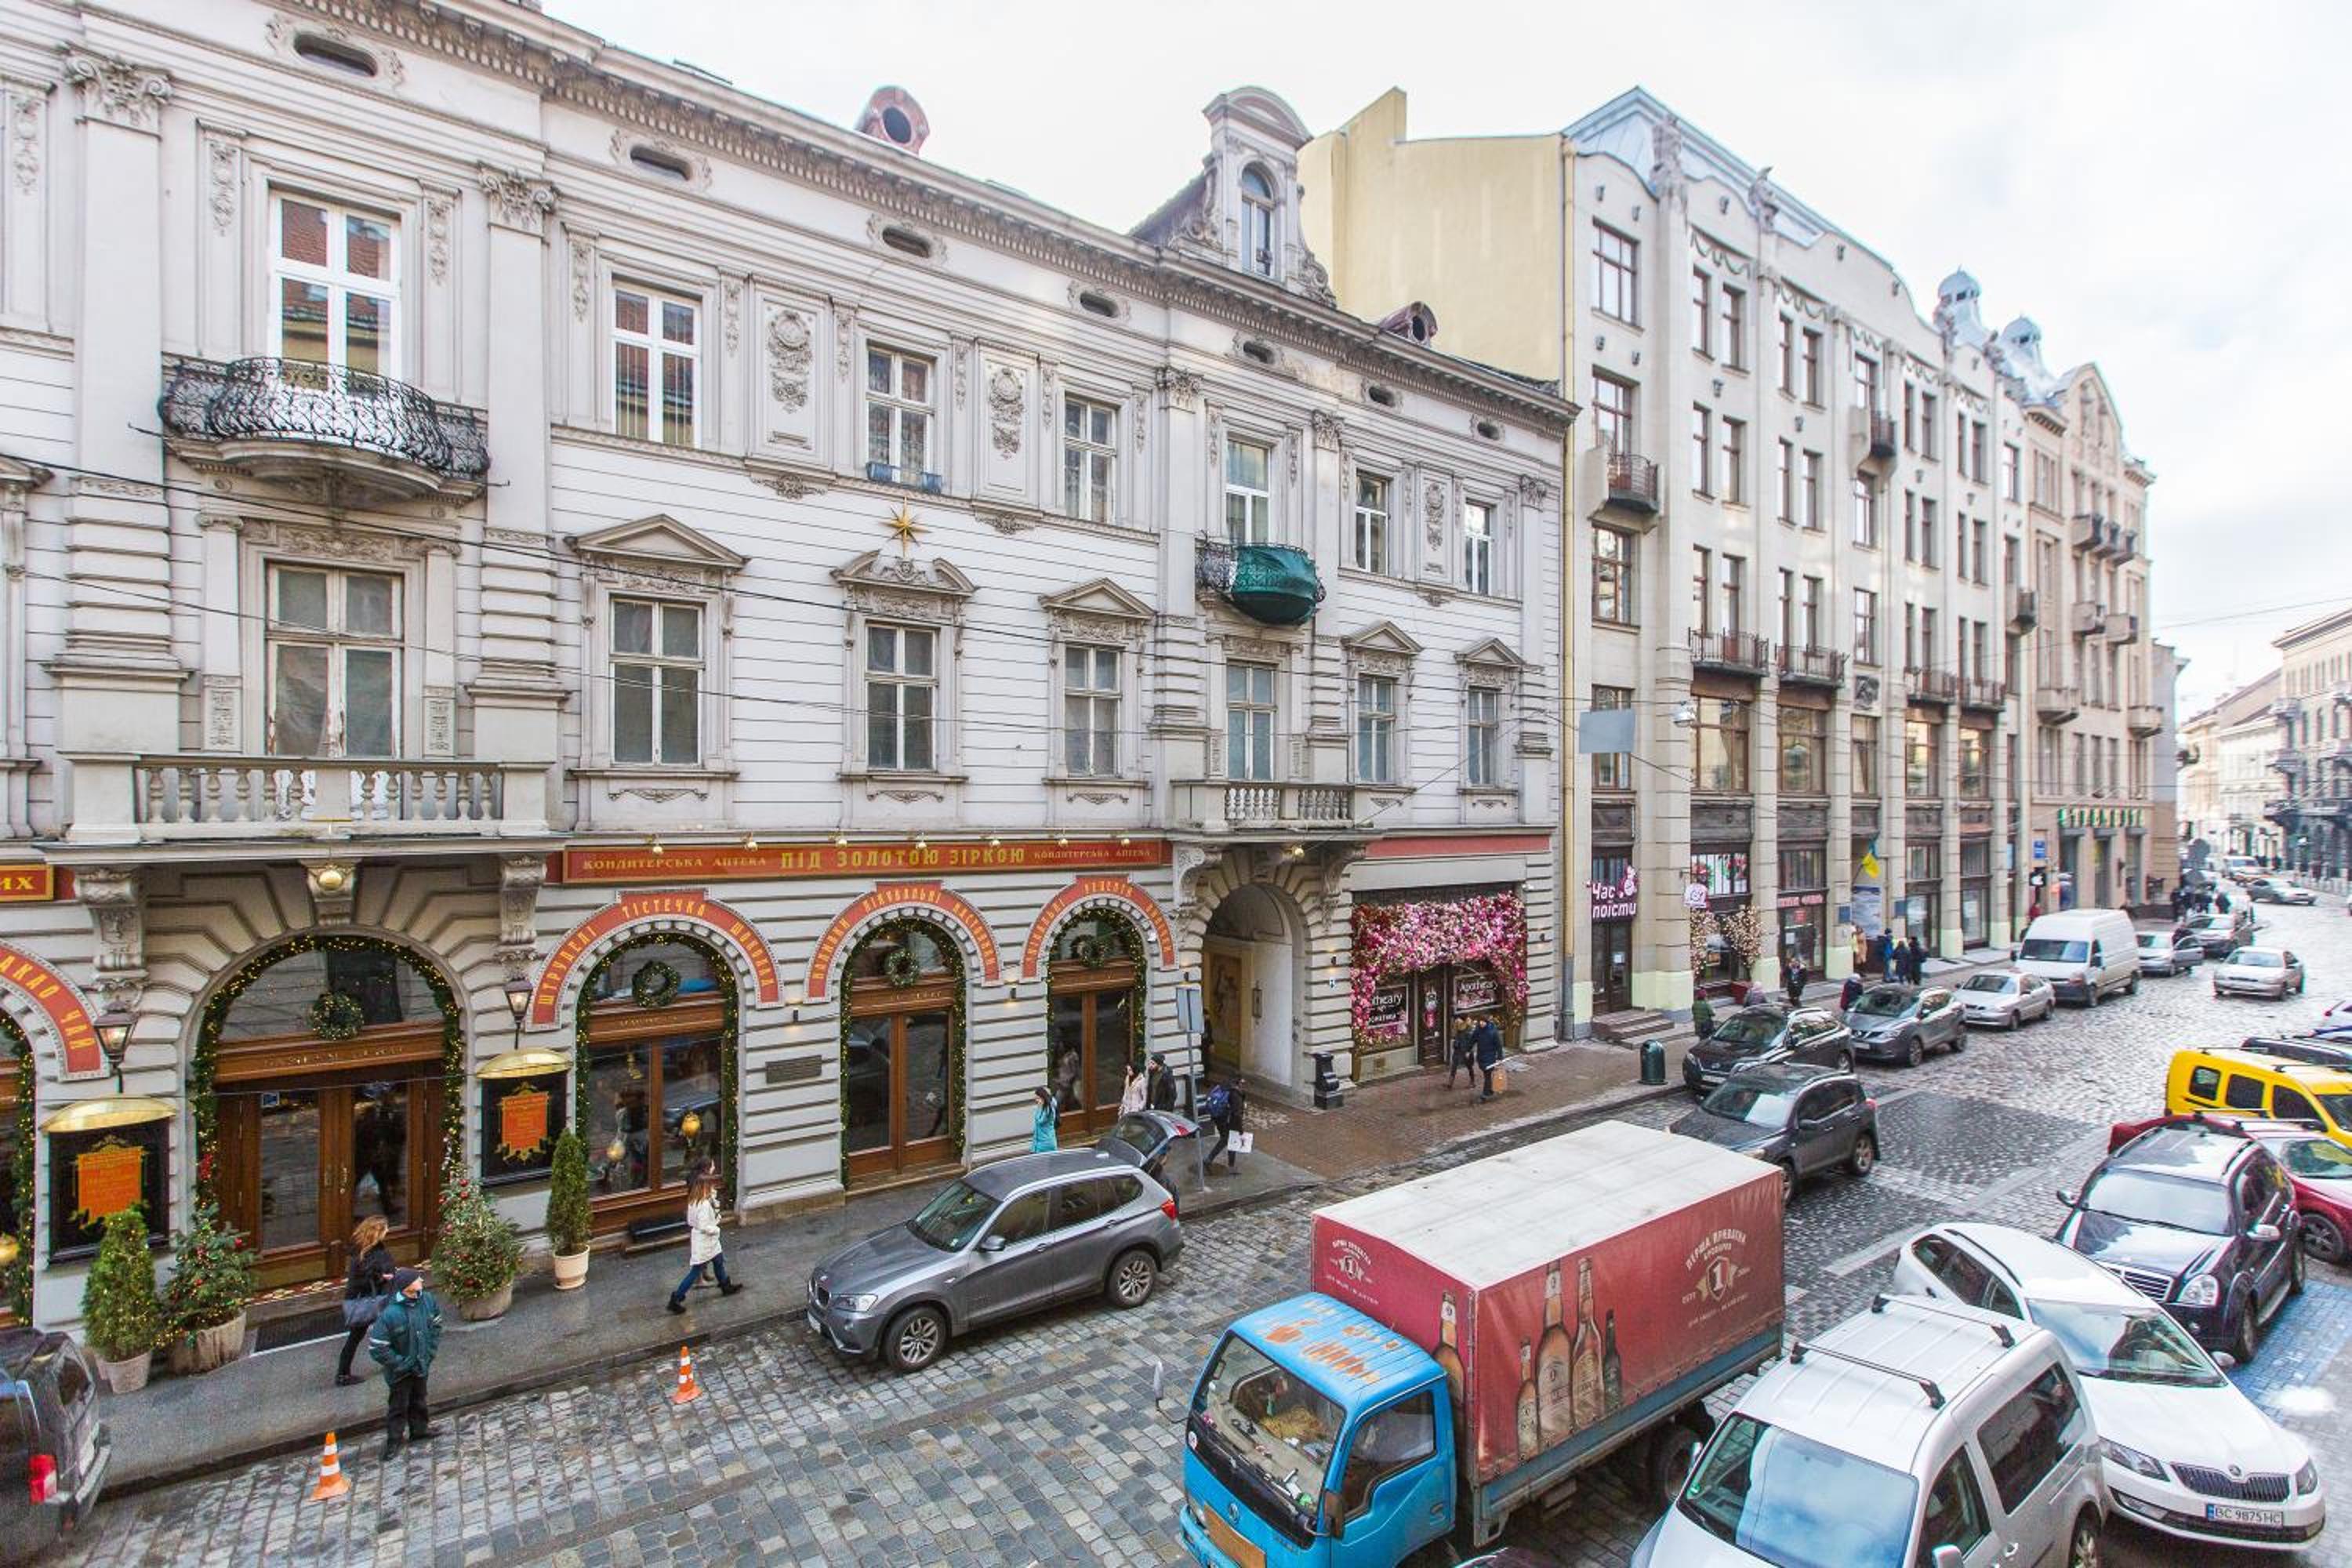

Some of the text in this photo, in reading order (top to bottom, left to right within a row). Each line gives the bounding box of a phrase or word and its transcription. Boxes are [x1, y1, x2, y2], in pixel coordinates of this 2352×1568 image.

[713, 856, 766, 866] АПТЕКА
[781, 851, 822, 869] ПІД
[837, 849, 940, 868] ЗОЛОТОЮ
[949, 848, 1025, 865] ЗІРКОЮ
[1592, 882, 1616, 900] Час
[1592, 899, 1636, 919] поїсти
[538, 925, 598, 1006] ШТРУДЕЛІ
[621, 897, 707, 918] ТІСТЕЧКА
